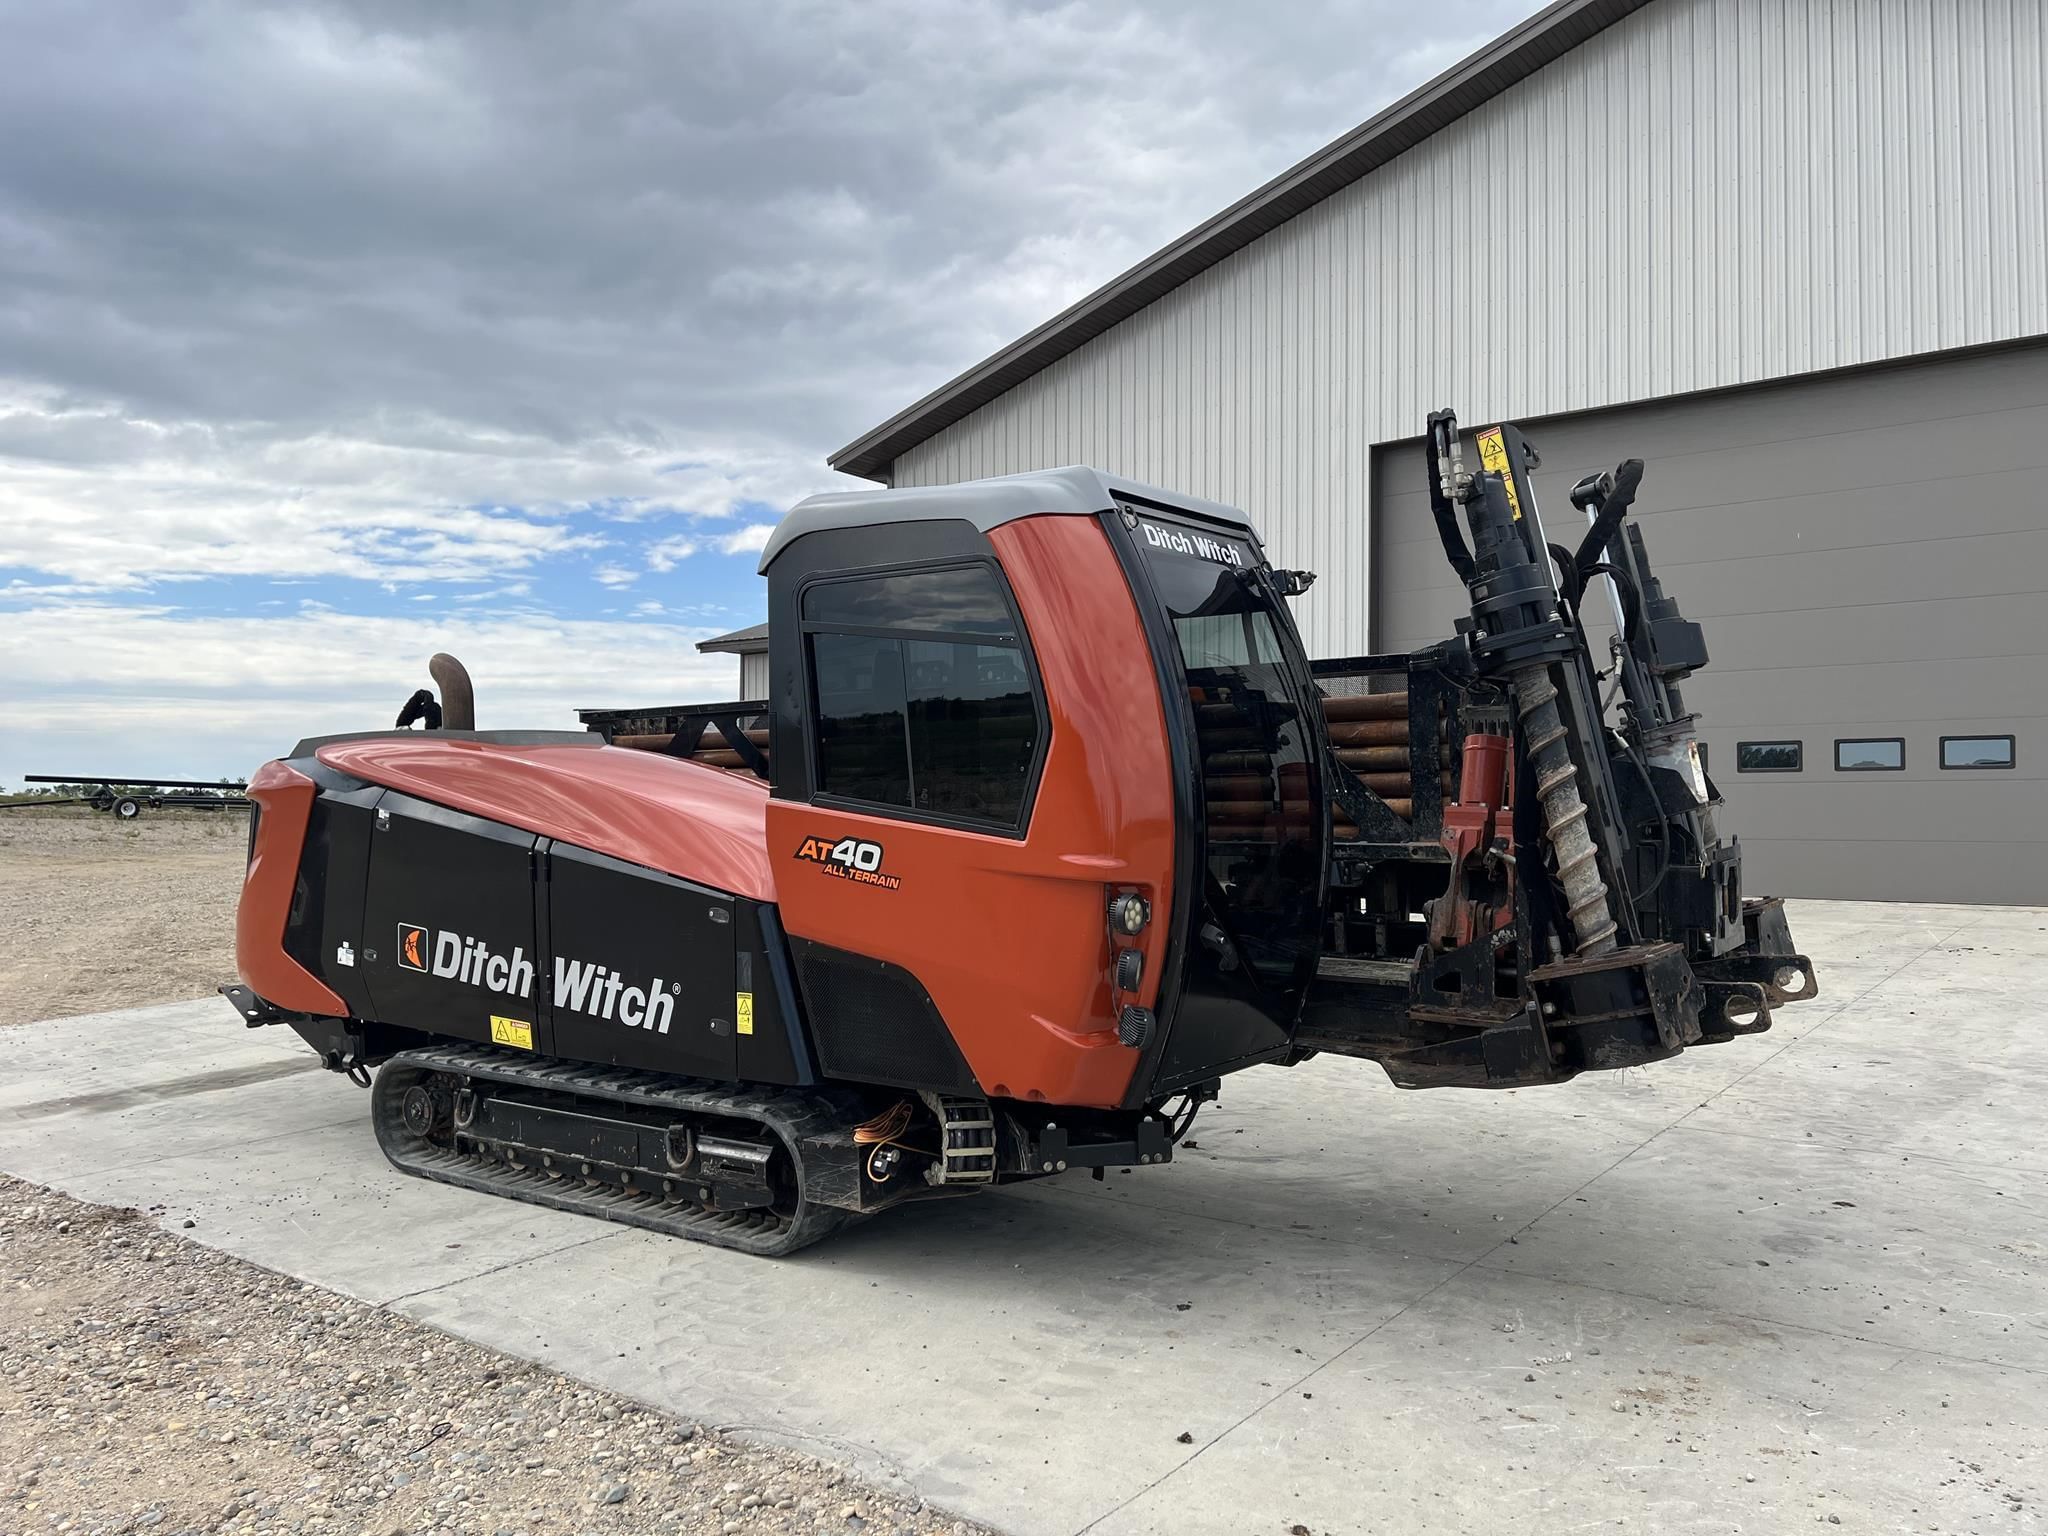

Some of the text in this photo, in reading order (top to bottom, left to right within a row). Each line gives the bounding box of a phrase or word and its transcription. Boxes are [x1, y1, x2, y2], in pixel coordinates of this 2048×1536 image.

[1142, 523, 1242, 566] Ditch Witch
[799, 839, 881, 872] AT40
[824, 864, 900, 889] ALL TERRAIN
[432, 930, 535, 998] Ditch
